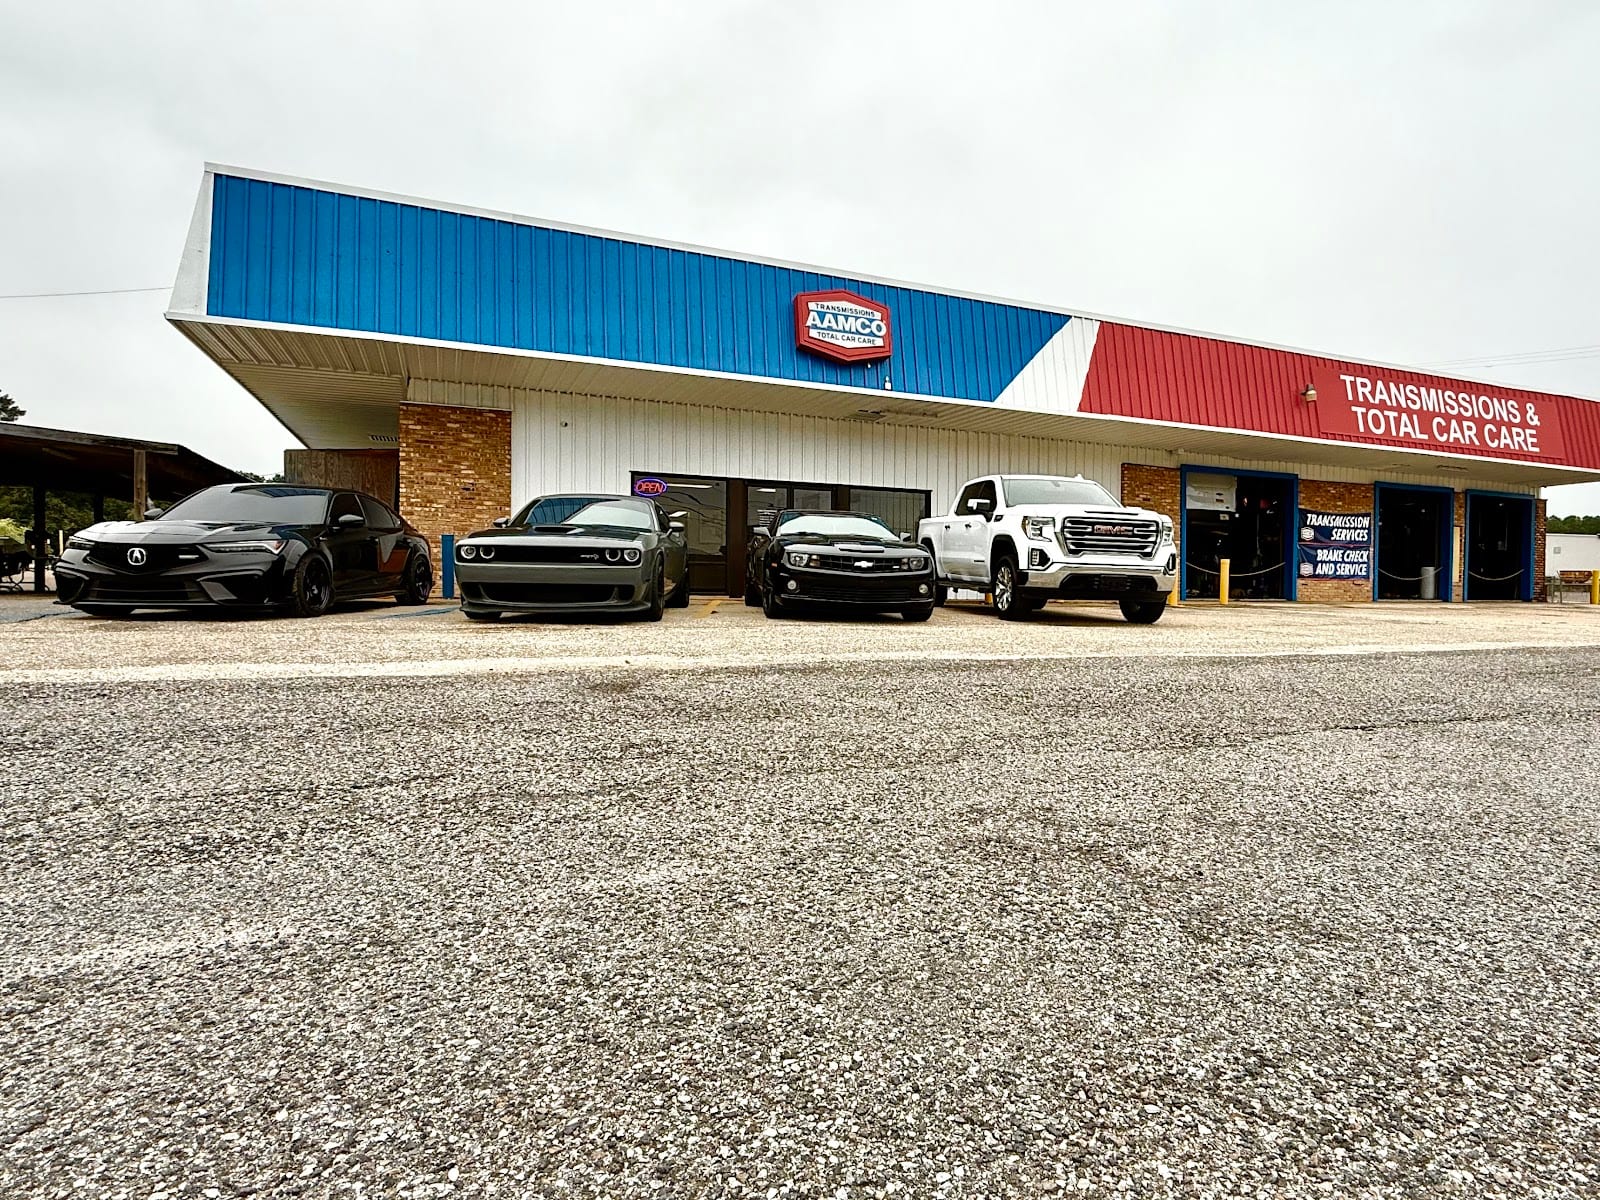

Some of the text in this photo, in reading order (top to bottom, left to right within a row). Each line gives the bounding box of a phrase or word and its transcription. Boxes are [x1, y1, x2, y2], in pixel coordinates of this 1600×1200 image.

[815, 302, 876, 318] TRANSMISSIONS
[805, 311, 887, 337] AAMCO
[817, 331, 839, 341] TOTAL
[857, 337, 876, 346] CARE
[1340, 374, 1541, 426] TRANSMISSIONS &
[1351, 406, 1540, 452] TOTAL CAR CARE
[636, 482, 663, 493] OPEN
[1306, 513, 1370, 528] TRANSMISSION
[1093, 525, 1133, 535] GMC
[1330, 528, 1368, 541] SERVICES
[1316, 549, 1369, 563] BRAKE CHECK
[1315, 562, 1335, 575] AND
[1336, 563, 1367, 576] SERVICE
